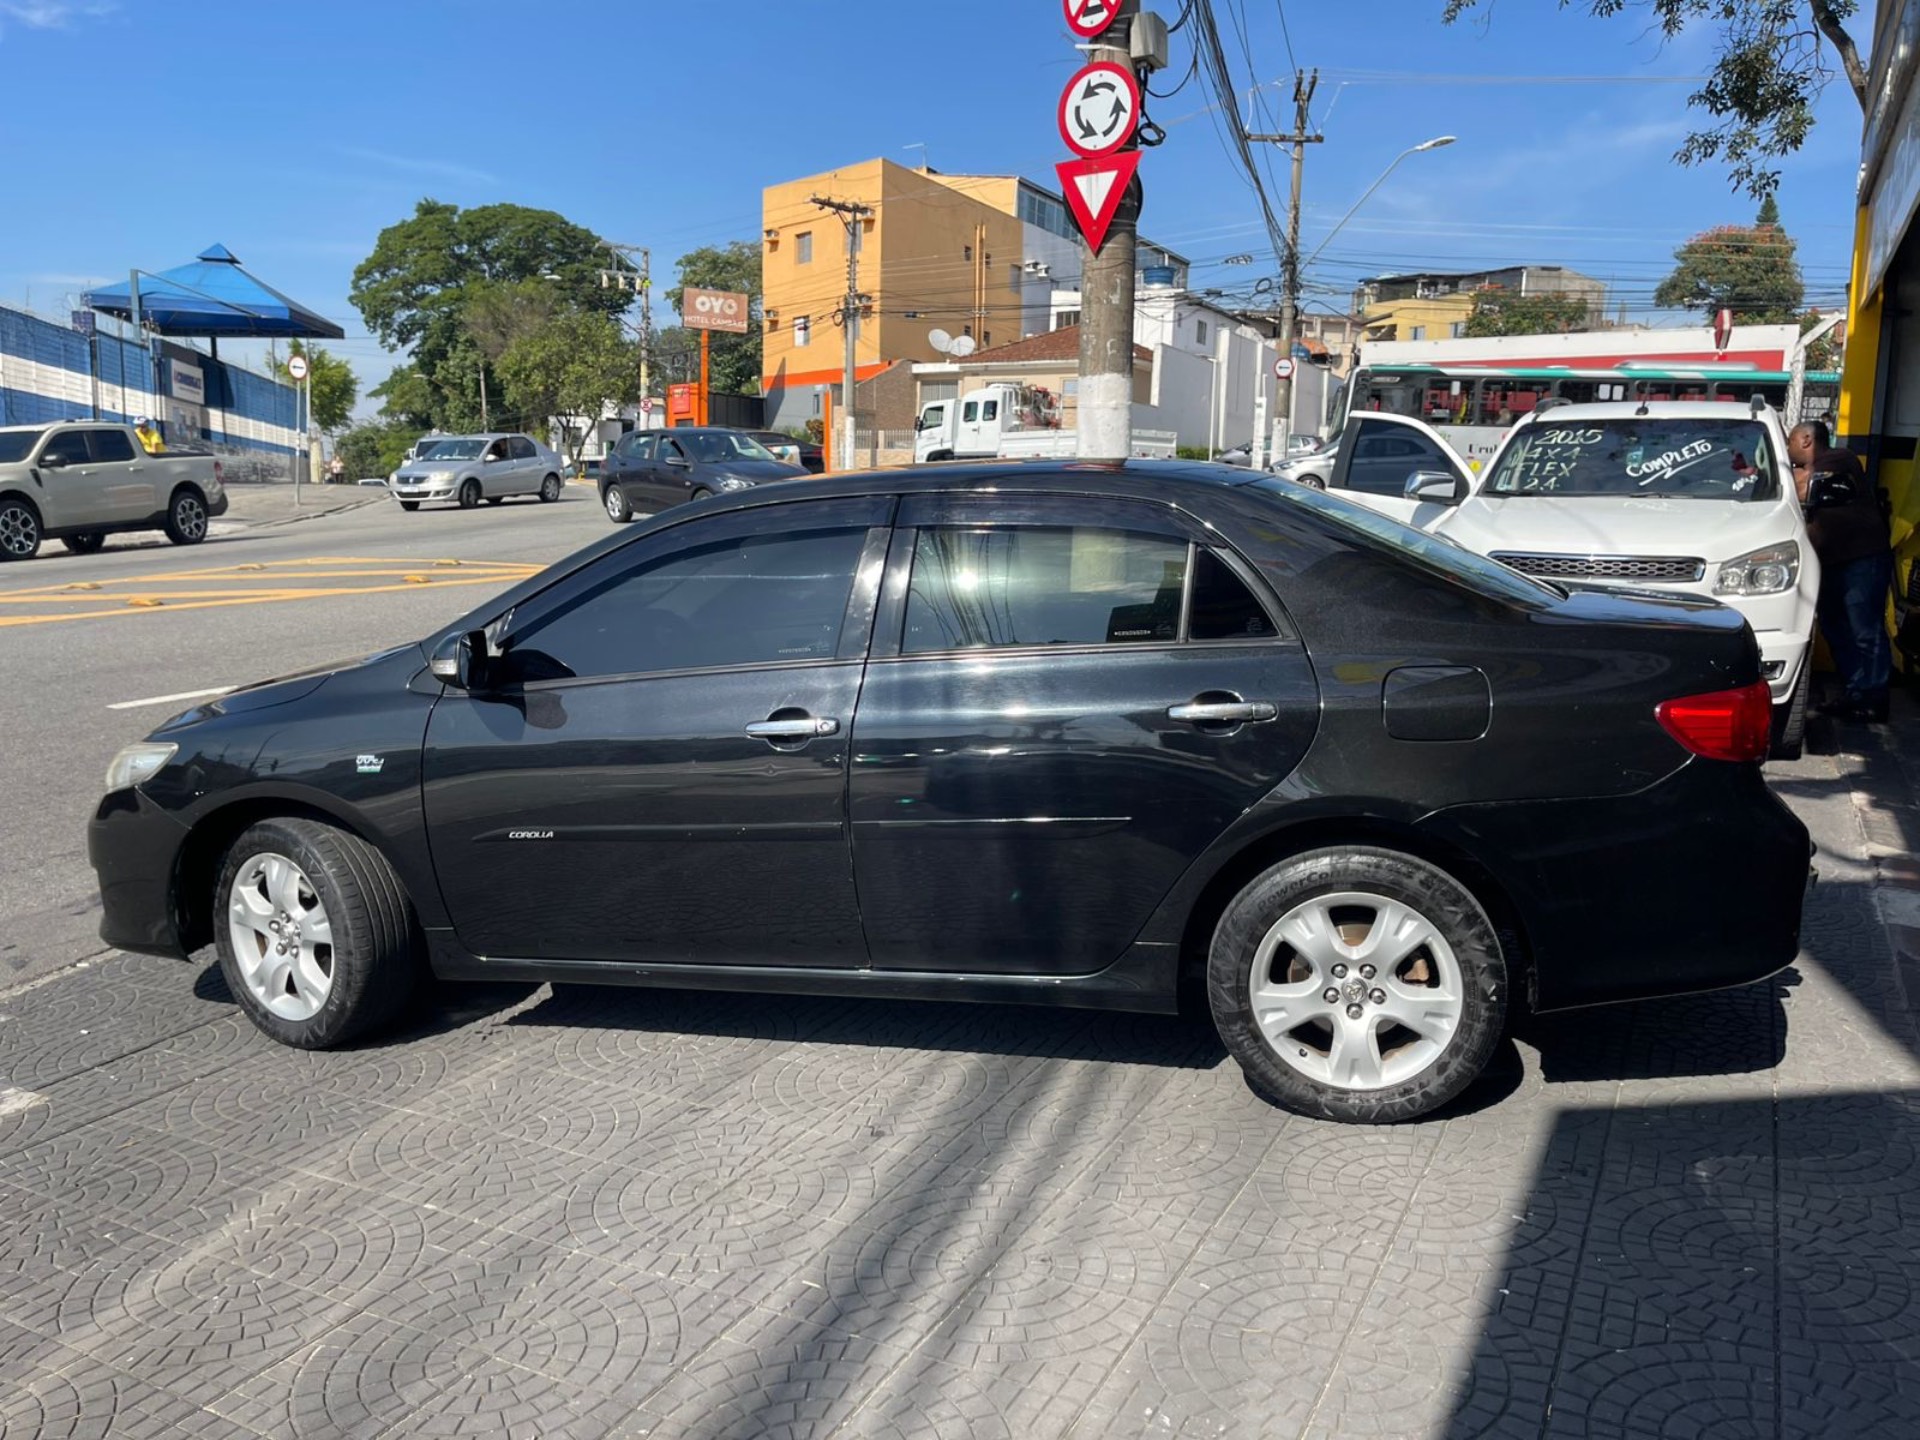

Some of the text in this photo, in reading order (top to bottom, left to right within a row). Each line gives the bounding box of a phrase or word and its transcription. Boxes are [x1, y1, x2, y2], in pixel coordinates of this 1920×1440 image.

[695, 295, 738, 315] OYO
[1534, 429, 1604, 445] 2015
[1626, 439, 1712, 477] COMPLETO
[1519, 461, 1577, 477] FLEX
[509, 831, 554, 839] COROLLA
